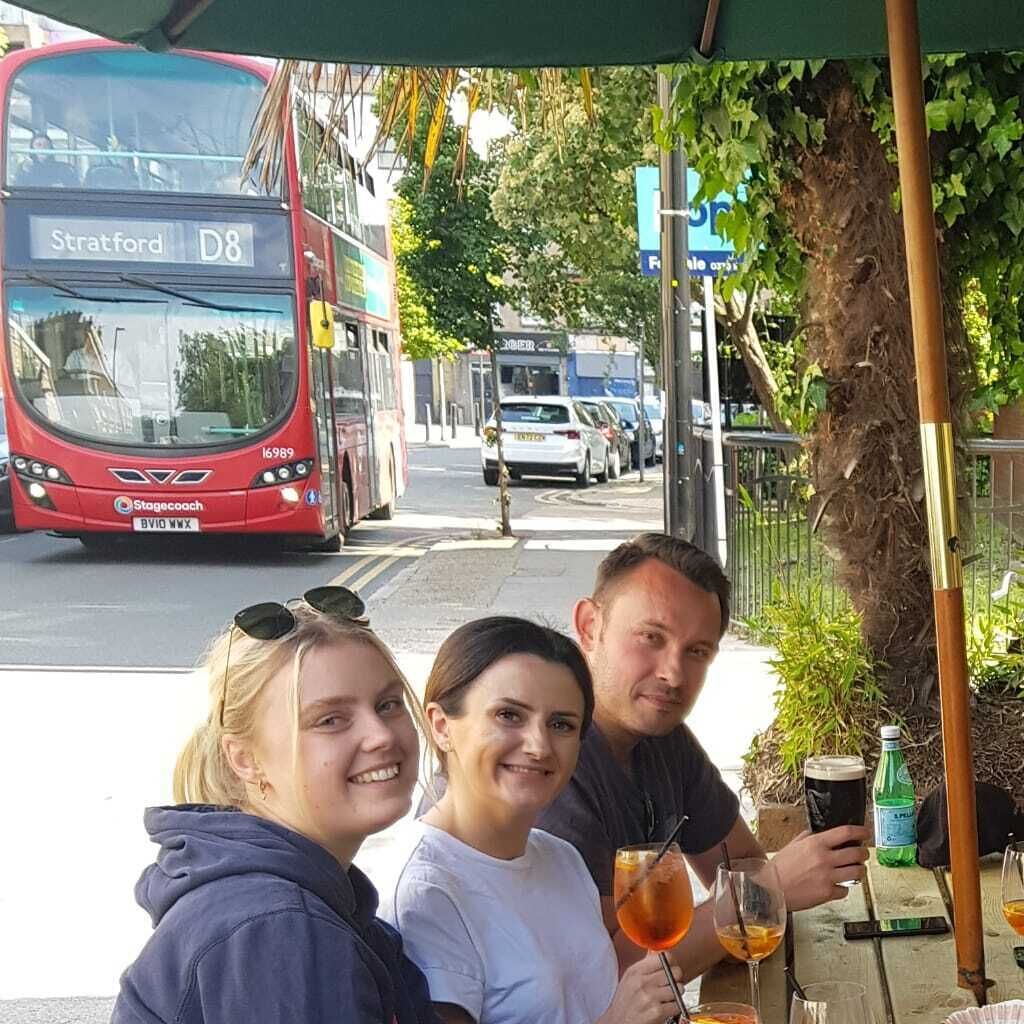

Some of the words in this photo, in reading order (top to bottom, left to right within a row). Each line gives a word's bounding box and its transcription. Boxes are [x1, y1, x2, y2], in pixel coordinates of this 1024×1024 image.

[51, 230, 164, 254] Stratford
[200, 228, 242, 262] D8
[262, 447, 294, 459] 16989
[133, 499, 204, 515] Stagecoach
[141, 519, 167, 529] BV10
[169, 519, 192, 529] WWX
